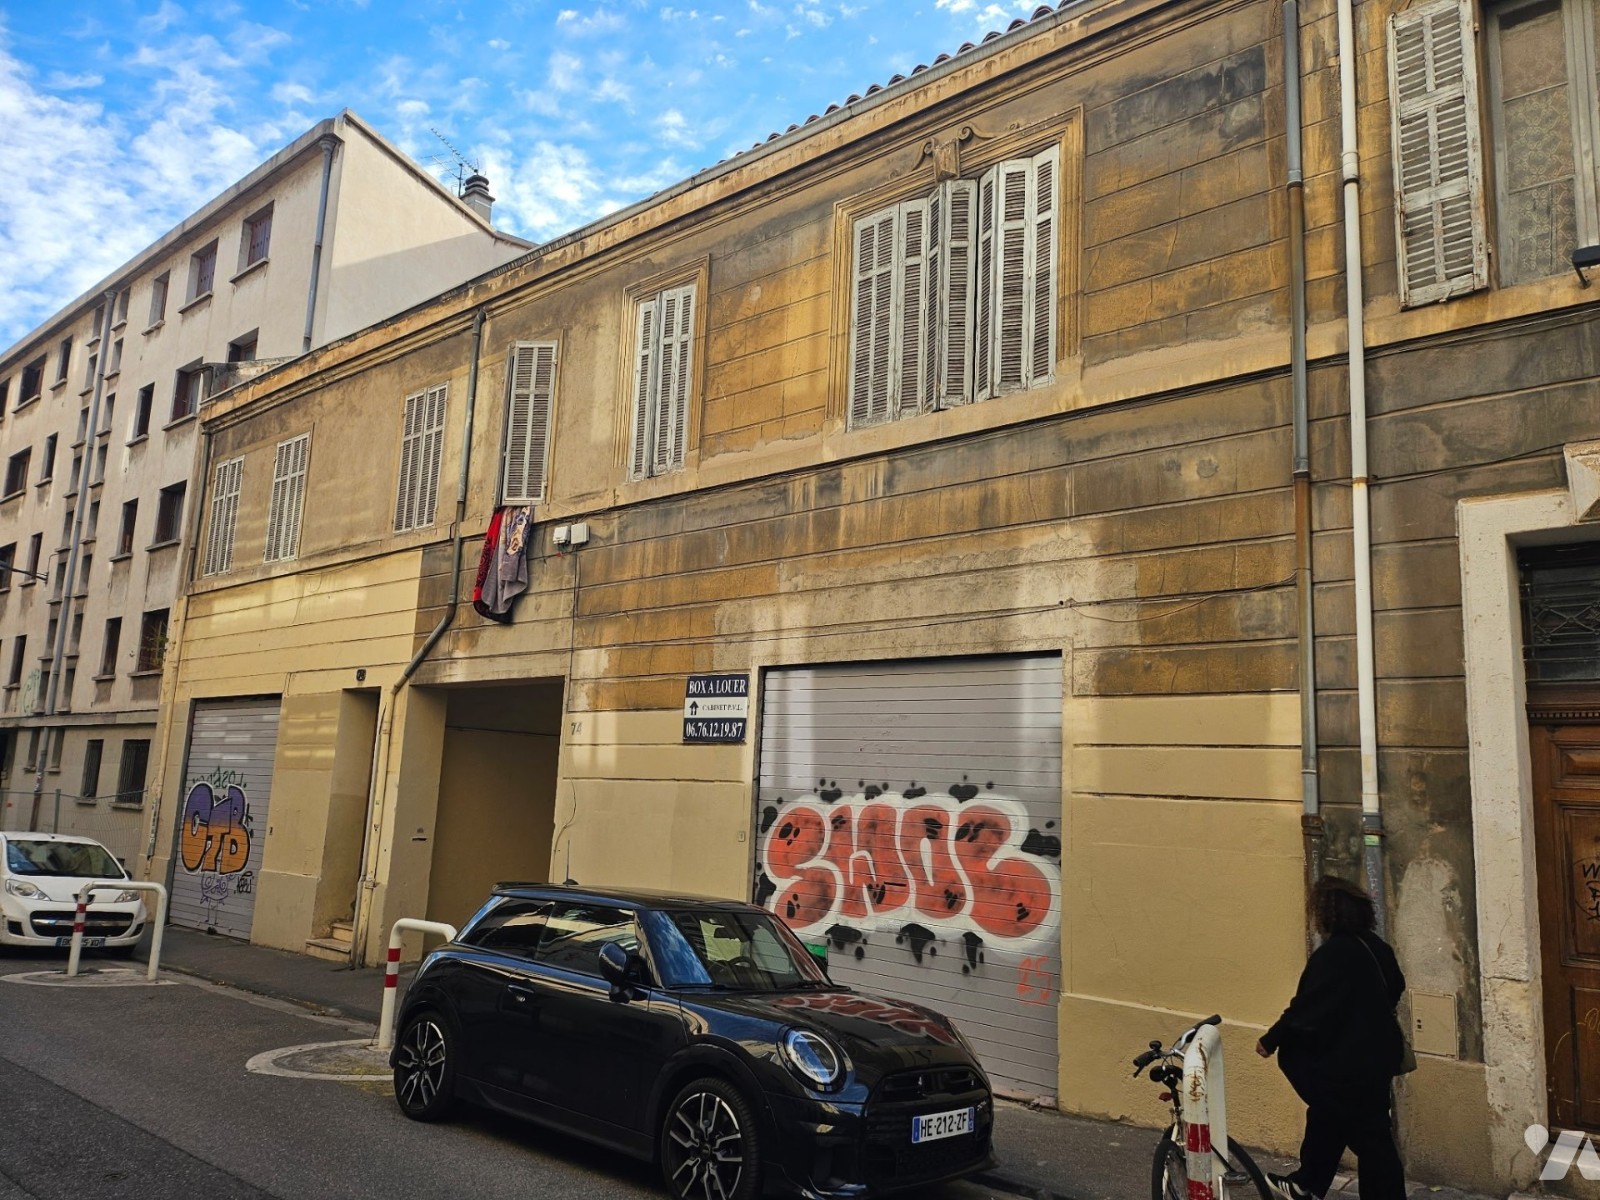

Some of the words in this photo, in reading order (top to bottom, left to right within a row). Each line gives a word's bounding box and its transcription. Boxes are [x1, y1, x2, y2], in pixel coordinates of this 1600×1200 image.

[689, 680, 706, 693] BOX
[708, 680, 714, 693] A
[716, 679, 746, 693] LOUER
[685, 721, 743, 738] 06.76.12.19.87
[920, 1112, 967, 1138] HE-212-ZF
